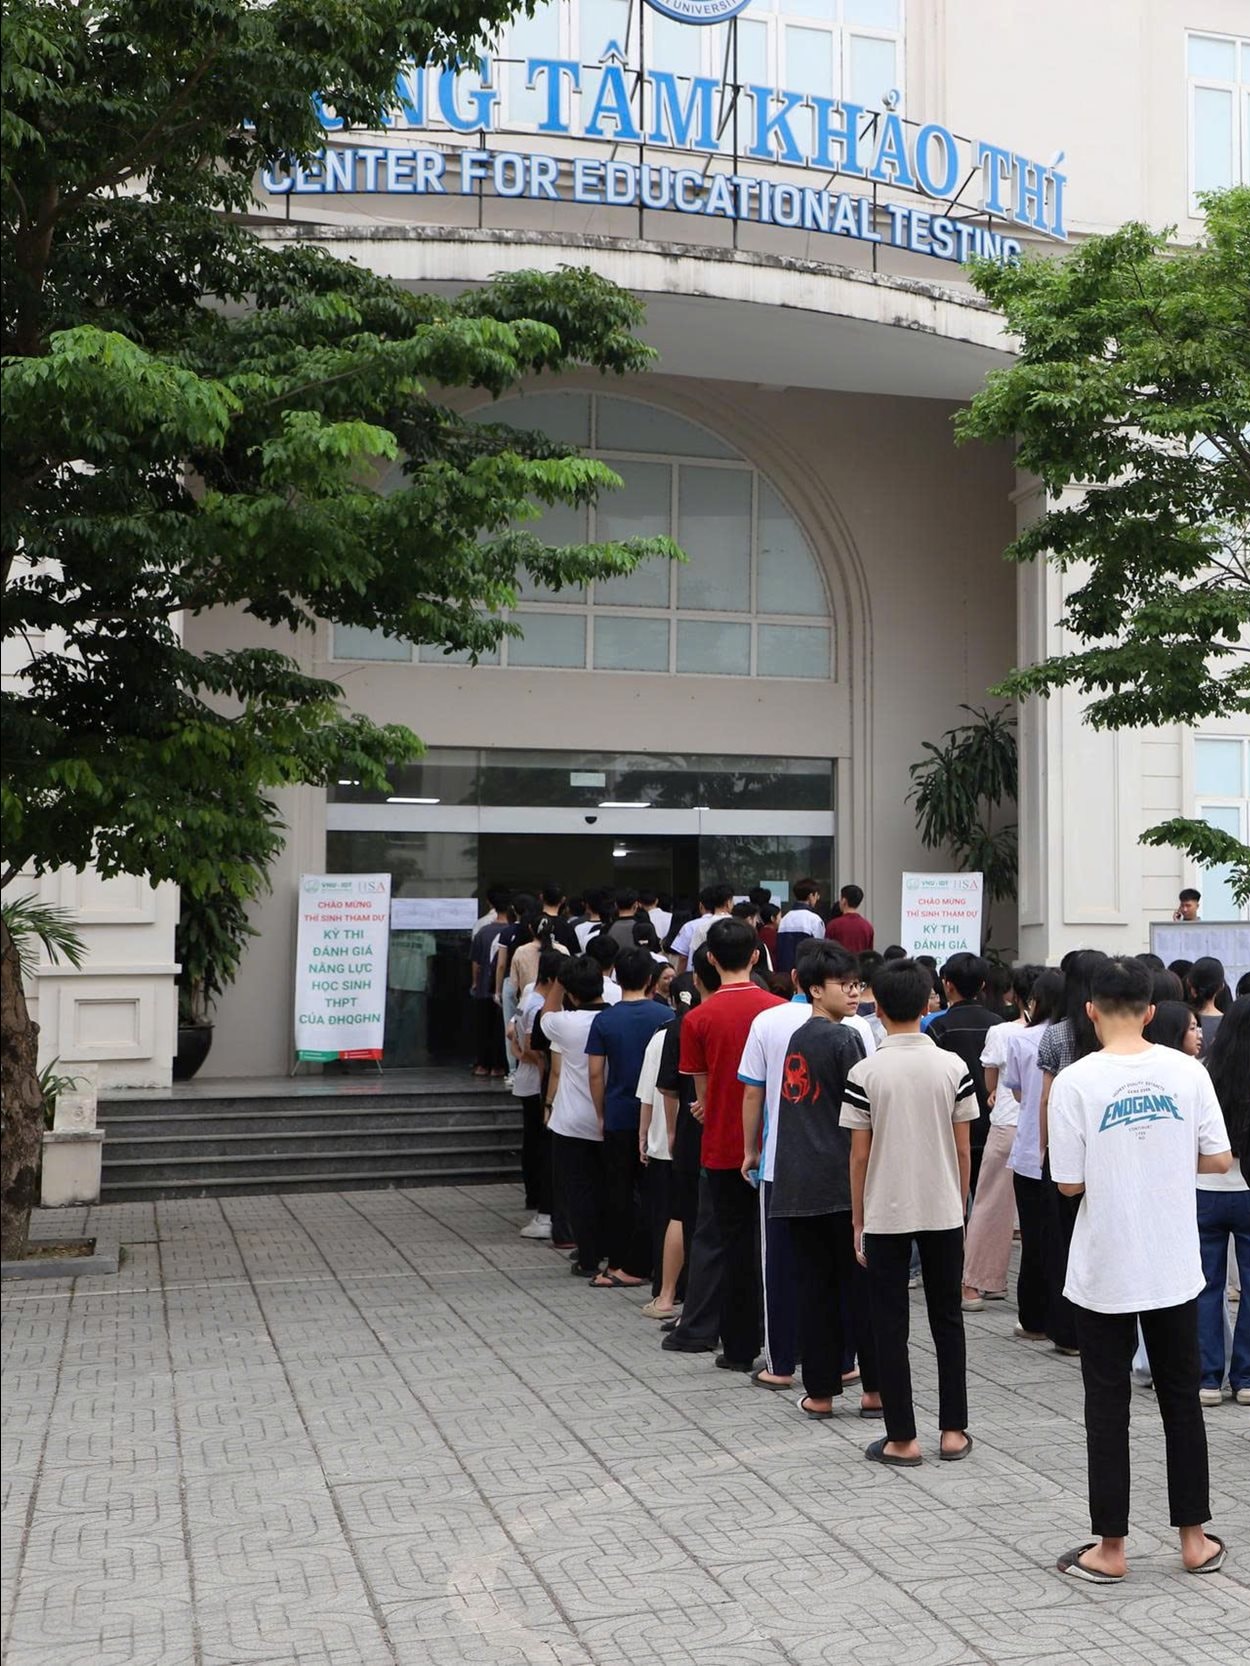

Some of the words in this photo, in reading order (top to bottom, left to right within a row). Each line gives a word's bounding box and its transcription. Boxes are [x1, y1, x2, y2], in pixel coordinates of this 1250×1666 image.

[673, 0, 737, 14] UNIVERSI
[525, 39, 721, 151] TÂM
[744, 89, 960, 200] KHẢO
[972, 139, 1069, 241] THÍ
[460, 149, 561, 199] FOR
[573, 157, 882, 243] EDUCATIONAL
[321, 914, 342, 922] SINH
[345, 914, 370, 922] THAM
[344, 929, 364, 939] THI
[941, 924, 960, 934] THI
[312, 945, 349, 956] ĐÁNH
[352, 944, 373, 956] GIÁ
[913, 939, 946, 950] ĐÁNH
[948, 938, 968, 950] GIÁ
[348, 963, 373, 975] LỰC
[312, 981, 339, 992] HỌC
[342, 980, 371, 990] SINH
[325, 997, 358, 1007] THPT
[299, 1012, 325, 1024] CỦA
[328, 1013, 381, 1025] ĐHQGHN
